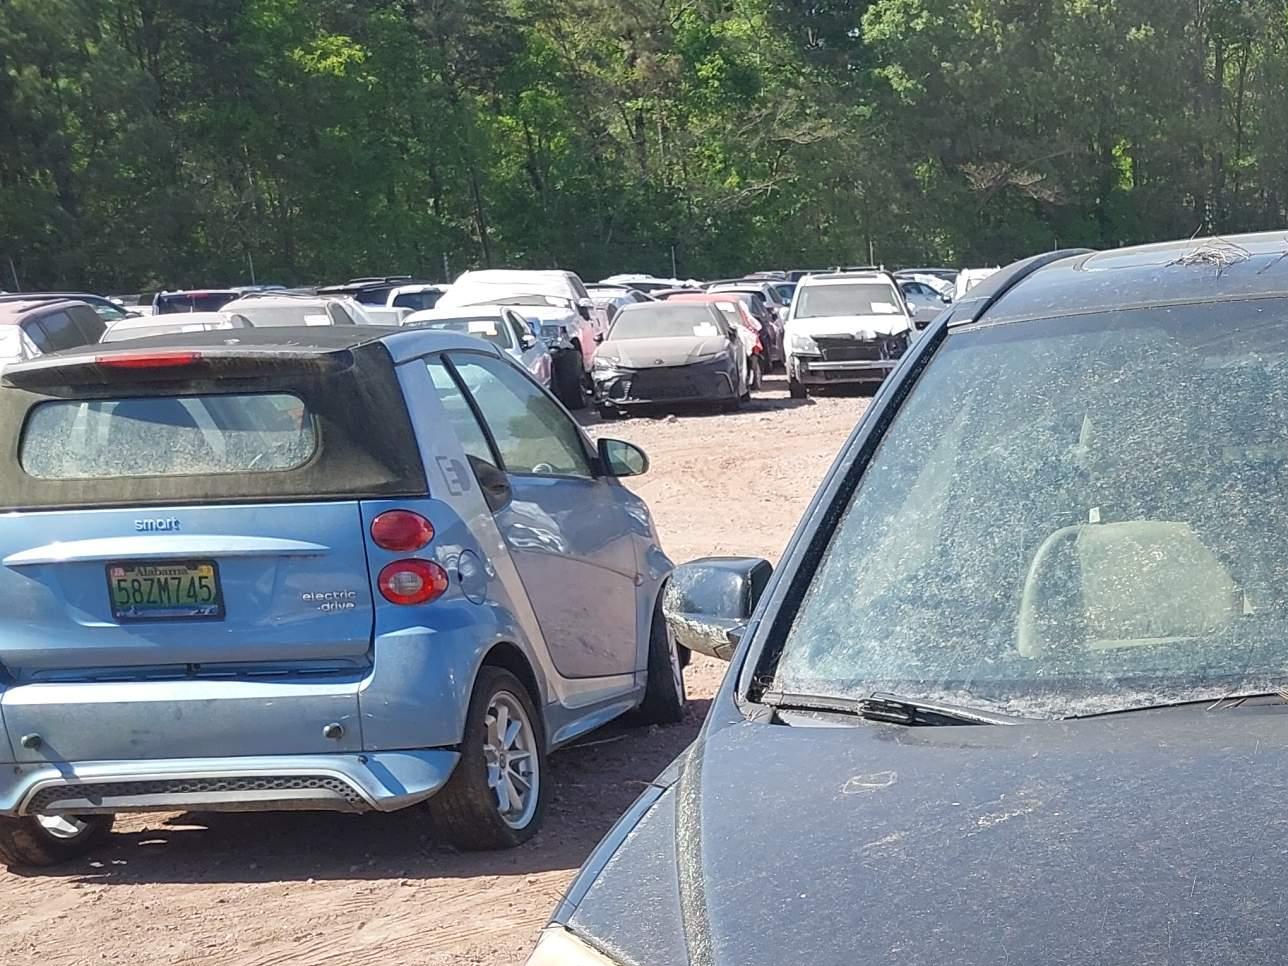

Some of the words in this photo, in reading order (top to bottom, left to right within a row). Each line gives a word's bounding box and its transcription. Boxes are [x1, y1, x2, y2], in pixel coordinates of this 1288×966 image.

[134, 516, 179, 531] smart
[116, 575, 213, 605] 58ZM745
[302, 589, 356, 601] electric
[320, 600, 355, 611] drive
